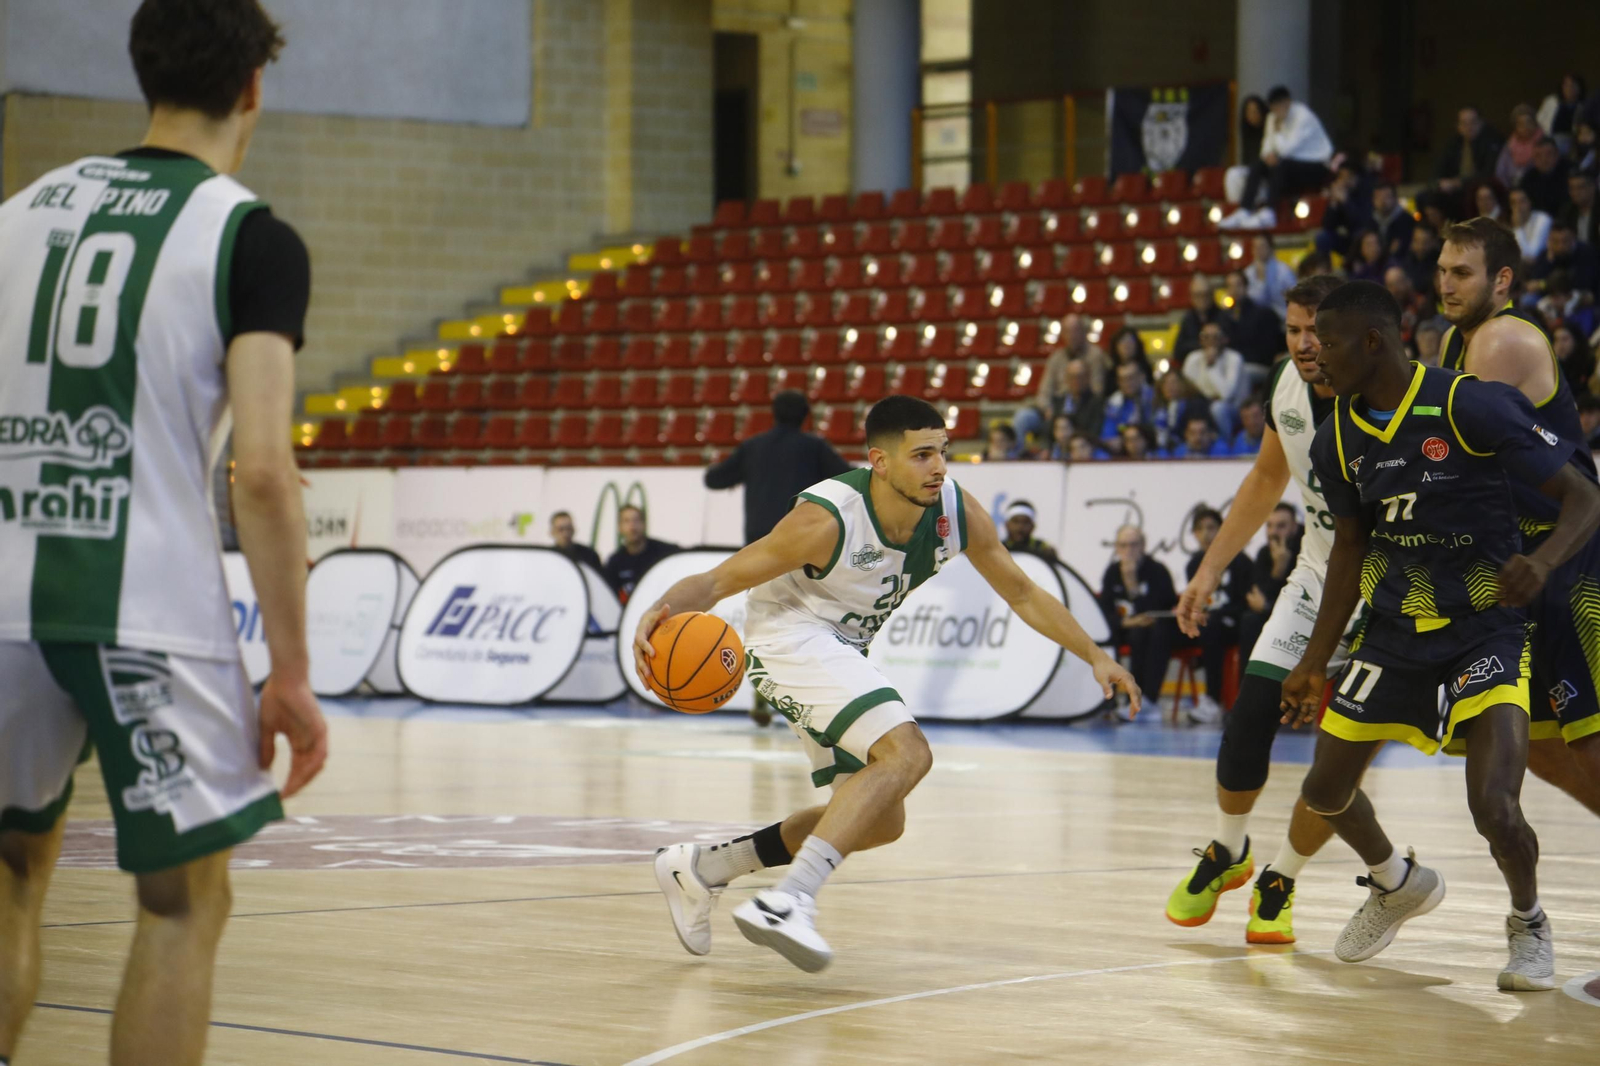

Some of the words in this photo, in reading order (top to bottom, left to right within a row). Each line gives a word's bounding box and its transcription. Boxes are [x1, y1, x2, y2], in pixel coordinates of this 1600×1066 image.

[29, 183, 76, 210] DEL
[92, 187, 170, 216] PINO
[26, 231, 136, 369] 18
[467, 603, 566, 644] PACC
[888, 605, 1013, 649] efficold
[1272, 637, 1305, 657] IMDEC
